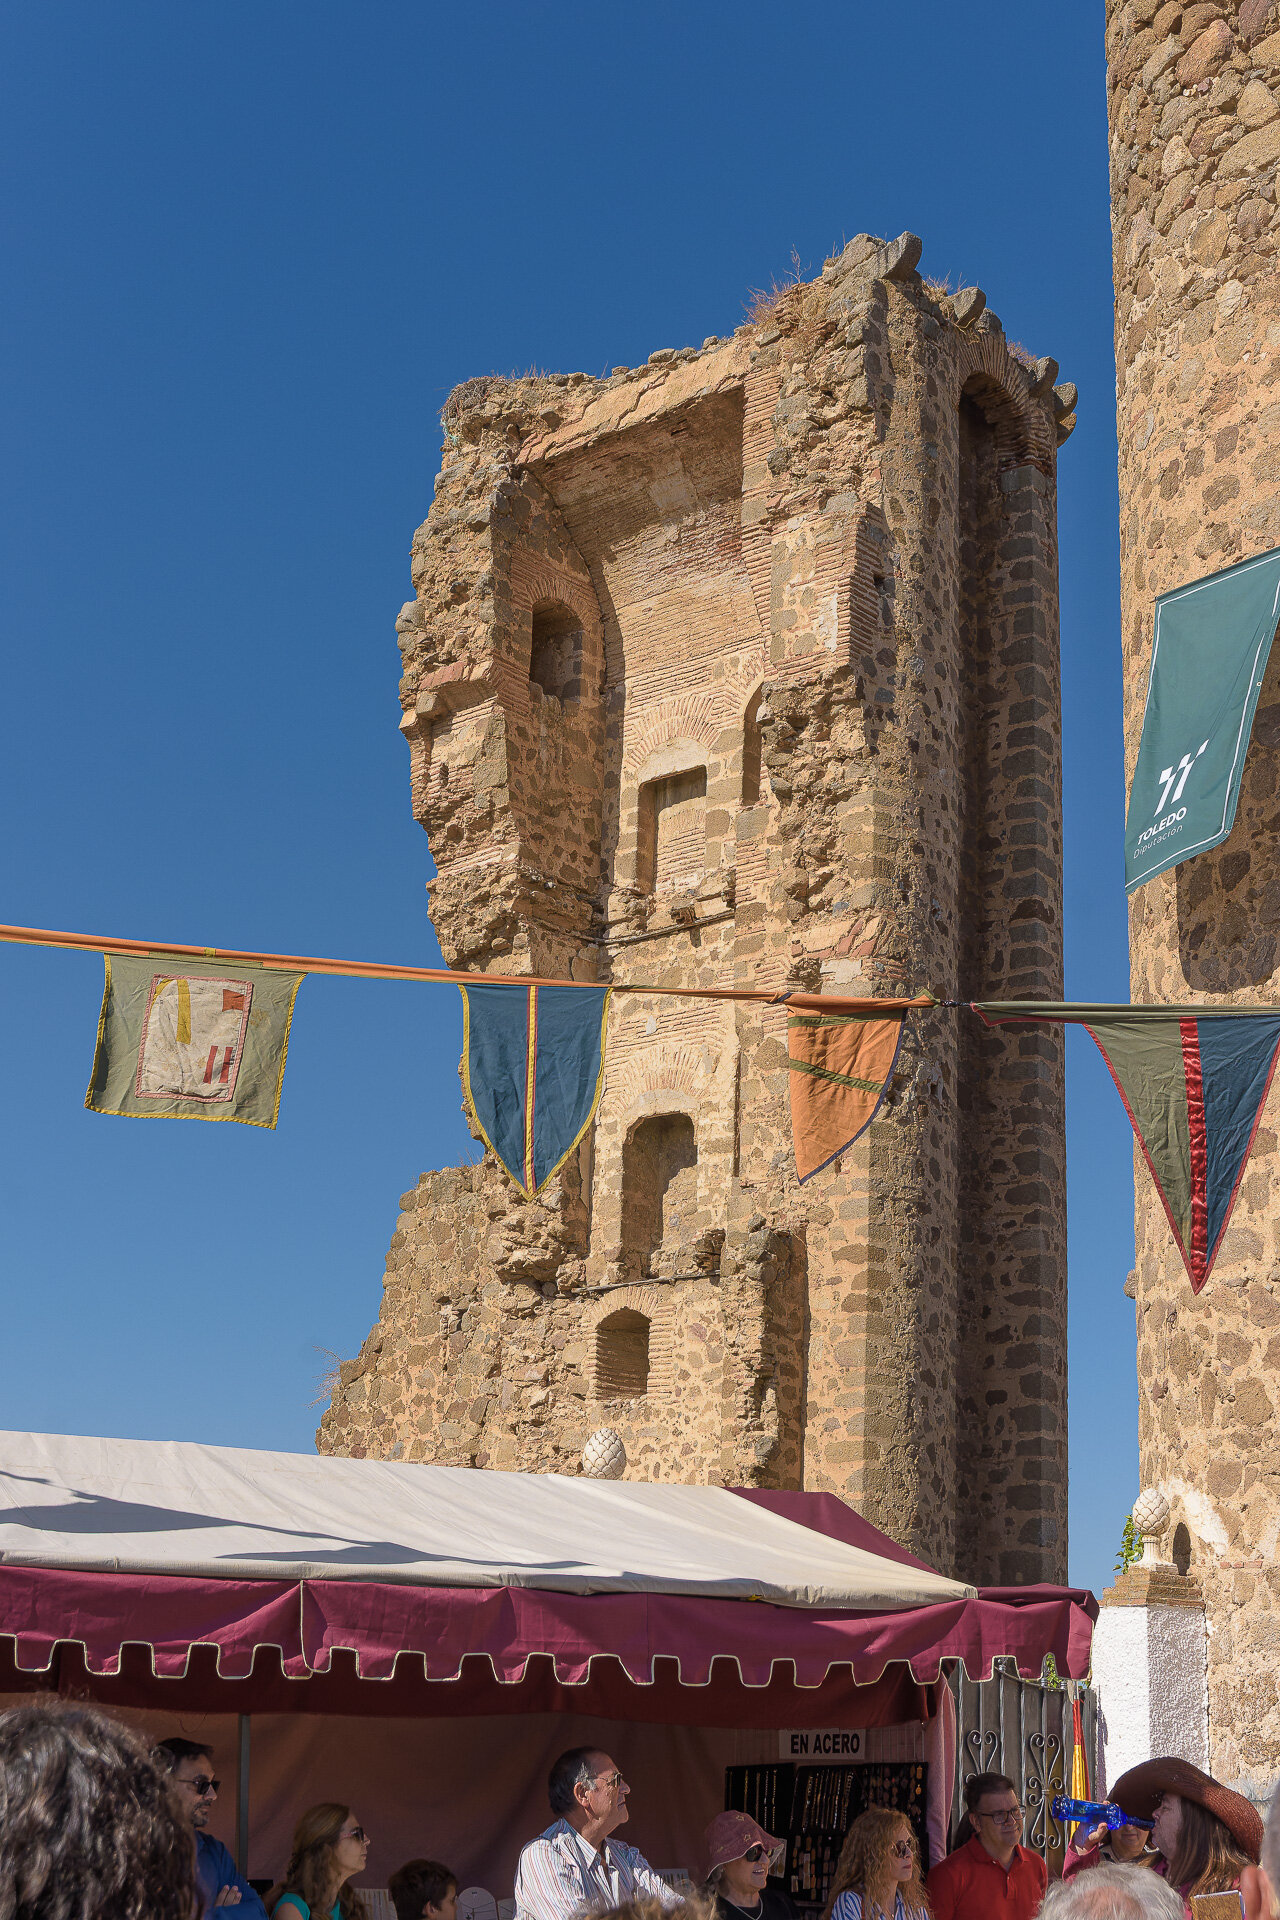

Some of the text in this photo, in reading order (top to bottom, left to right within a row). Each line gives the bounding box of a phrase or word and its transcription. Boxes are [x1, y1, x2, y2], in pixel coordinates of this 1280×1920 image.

[1133, 825, 1183, 859] Diputación
[1137, 806, 1187, 845] TOLEDO
[790, 1733, 860, 1754] EN ACERO
